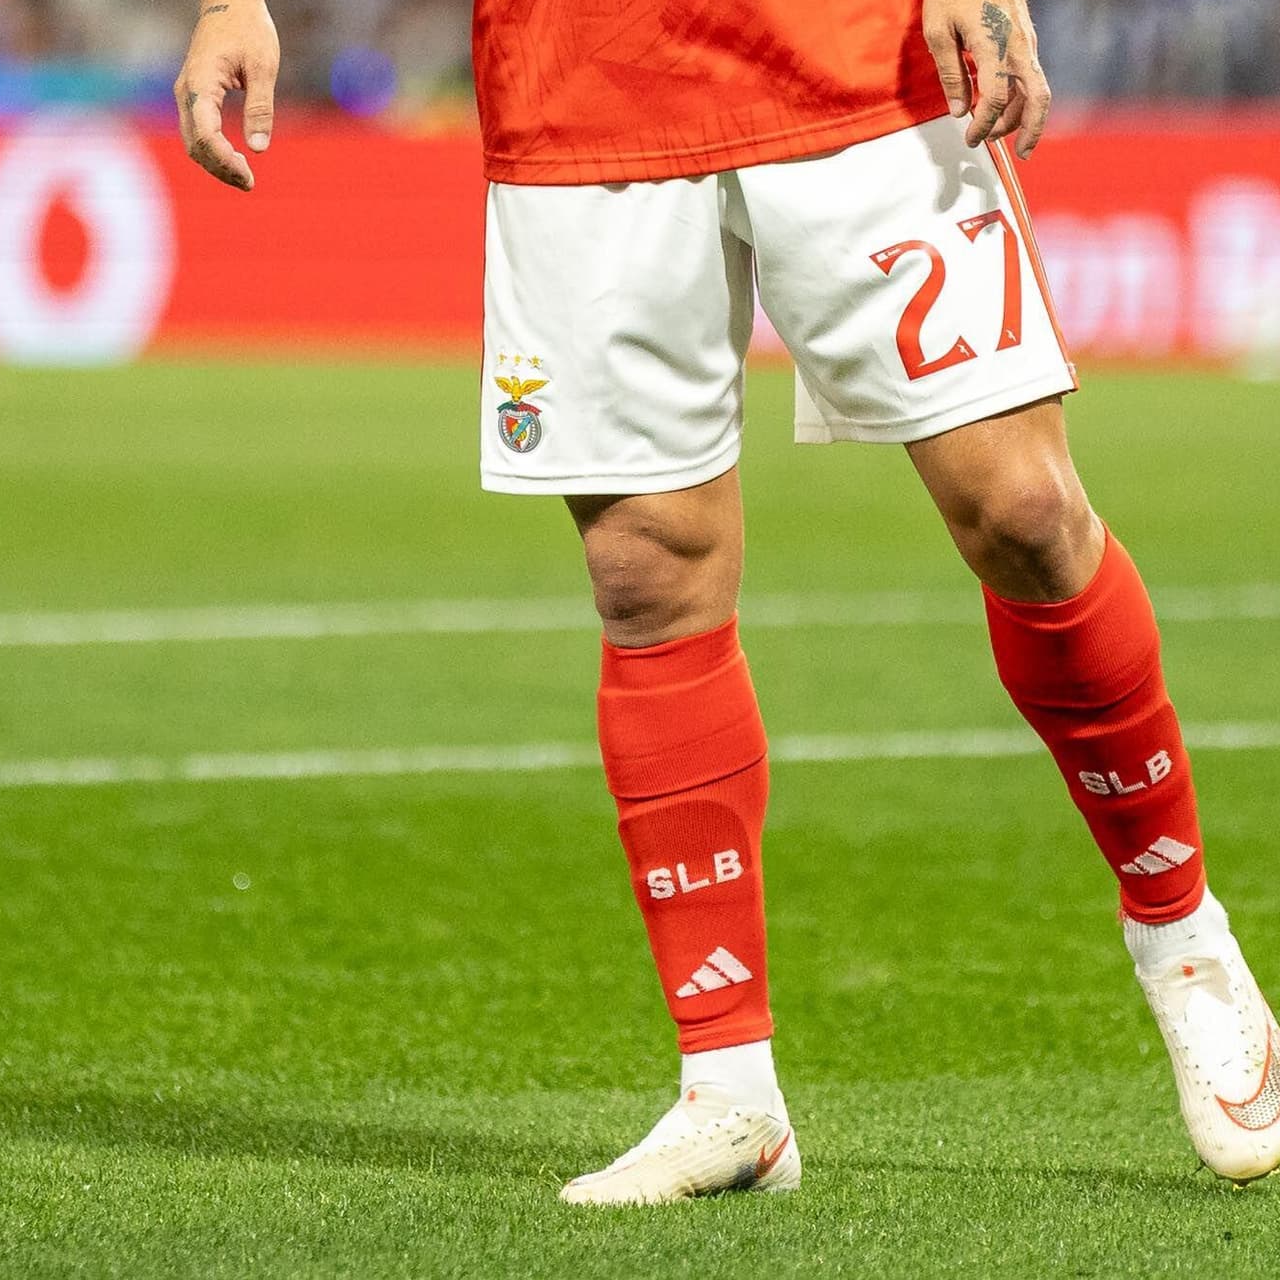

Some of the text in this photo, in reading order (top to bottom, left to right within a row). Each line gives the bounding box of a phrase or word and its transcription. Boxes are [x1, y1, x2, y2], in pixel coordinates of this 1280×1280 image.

[868, 209, 1022, 381] 27
[1078, 749, 1172, 796] SLB
[647, 848, 745, 900] SLB
